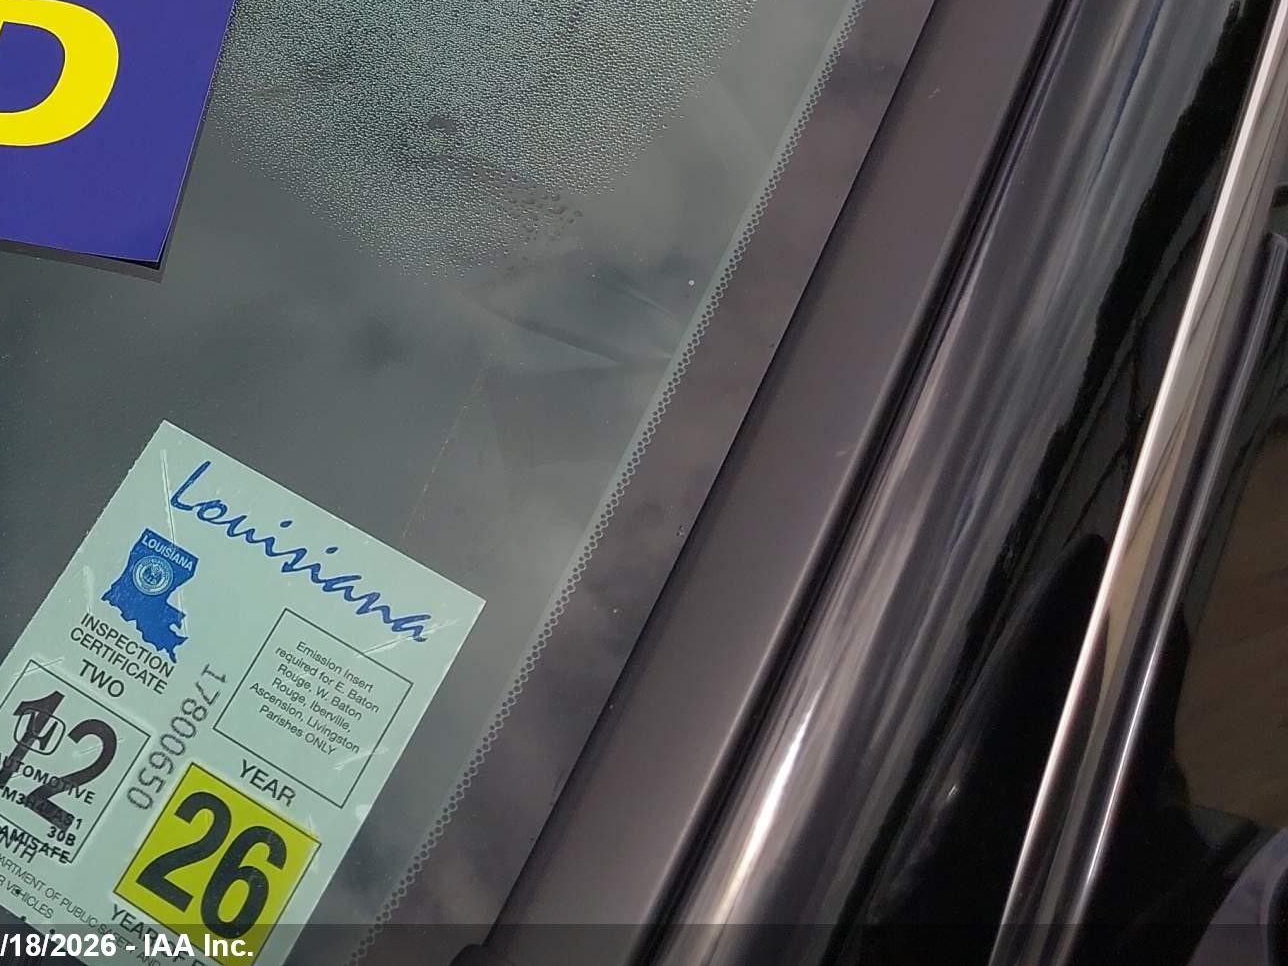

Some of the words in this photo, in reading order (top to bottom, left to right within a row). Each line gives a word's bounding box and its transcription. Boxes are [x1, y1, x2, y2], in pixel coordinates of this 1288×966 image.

[141, 534, 193, 572] LOUISIANA
[170, 460, 432, 643] Louisiana
[70, 627, 168, 695] CERTIFICATE
[80, 612, 175, 678] INSPECTION
[296, 641, 343, 675] Emission
[343, 669, 374, 694] Insert
[78, 658, 125, 698] TWO
[271, 677, 307, 707] Rouge,
[309, 700, 352, 733] Iberville,
[275, 646, 319, 677] required
[318, 670, 335, 686] for
[334, 681, 345, 694] E.
[347, 688, 380, 714] Baton
[277, 663, 312, 692] Rouge,
[316, 685, 328, 701] W.
[330, 695, 363, 721] Baton
[126, 663, 227, 811] 17800650
[250, 682, 304, 722] Ascension,
[306, 715, 361, 754] Livingston
[259, 704, 303, 738] Parishes
[304, 732, 337, 756] ONLY
[12, 690, 117, 833] 12
[239, 758, 297, 807] YEAR
[47, 825, 77, 847] 30B
[135, 791, 288, 939] 26
[5, 882, 55, 920] VEHICLES
[45, 886, 61, 902] OF
[60, 896, 99, 930] PUBLIC
